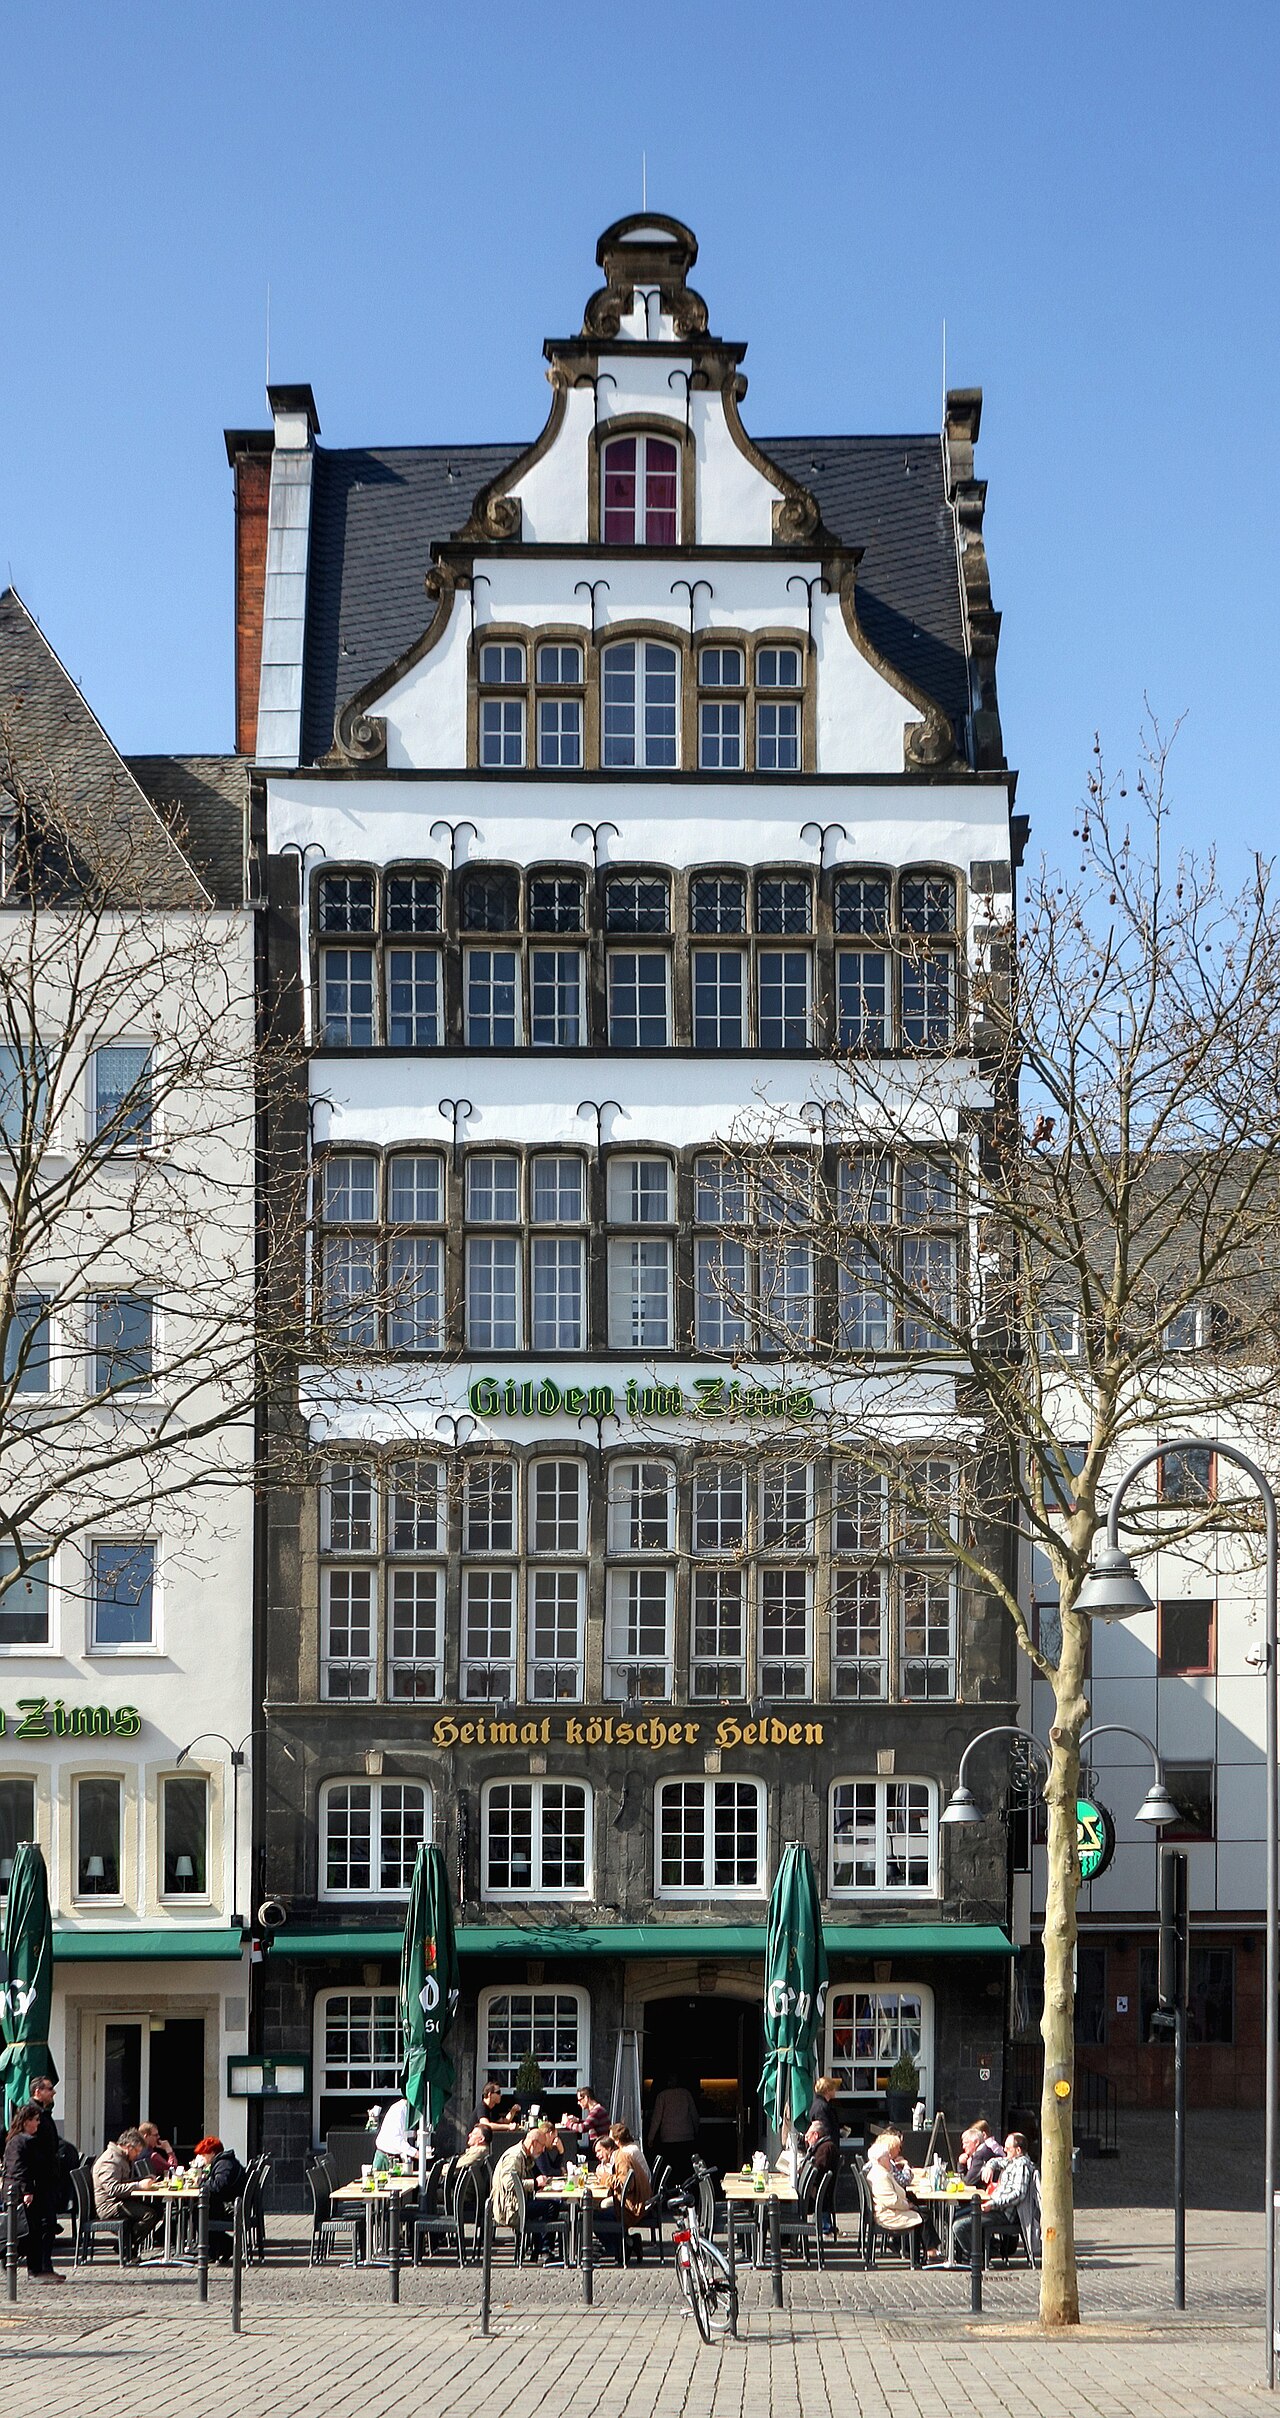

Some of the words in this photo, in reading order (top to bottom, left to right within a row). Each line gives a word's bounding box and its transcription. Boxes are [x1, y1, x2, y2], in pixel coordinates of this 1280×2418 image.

[467, 1375, 617, 1418] Gilden
[624, 1378, 684, 1417] im
[692, 1377, 817, 1418] Zims
[13, 1696, 142, 1740] Zims
[431, 1716, 552, 1749] Heimat
[566, 1716, 701, 1750] kölscher
[714, 1716, 824, 1750] Helden
